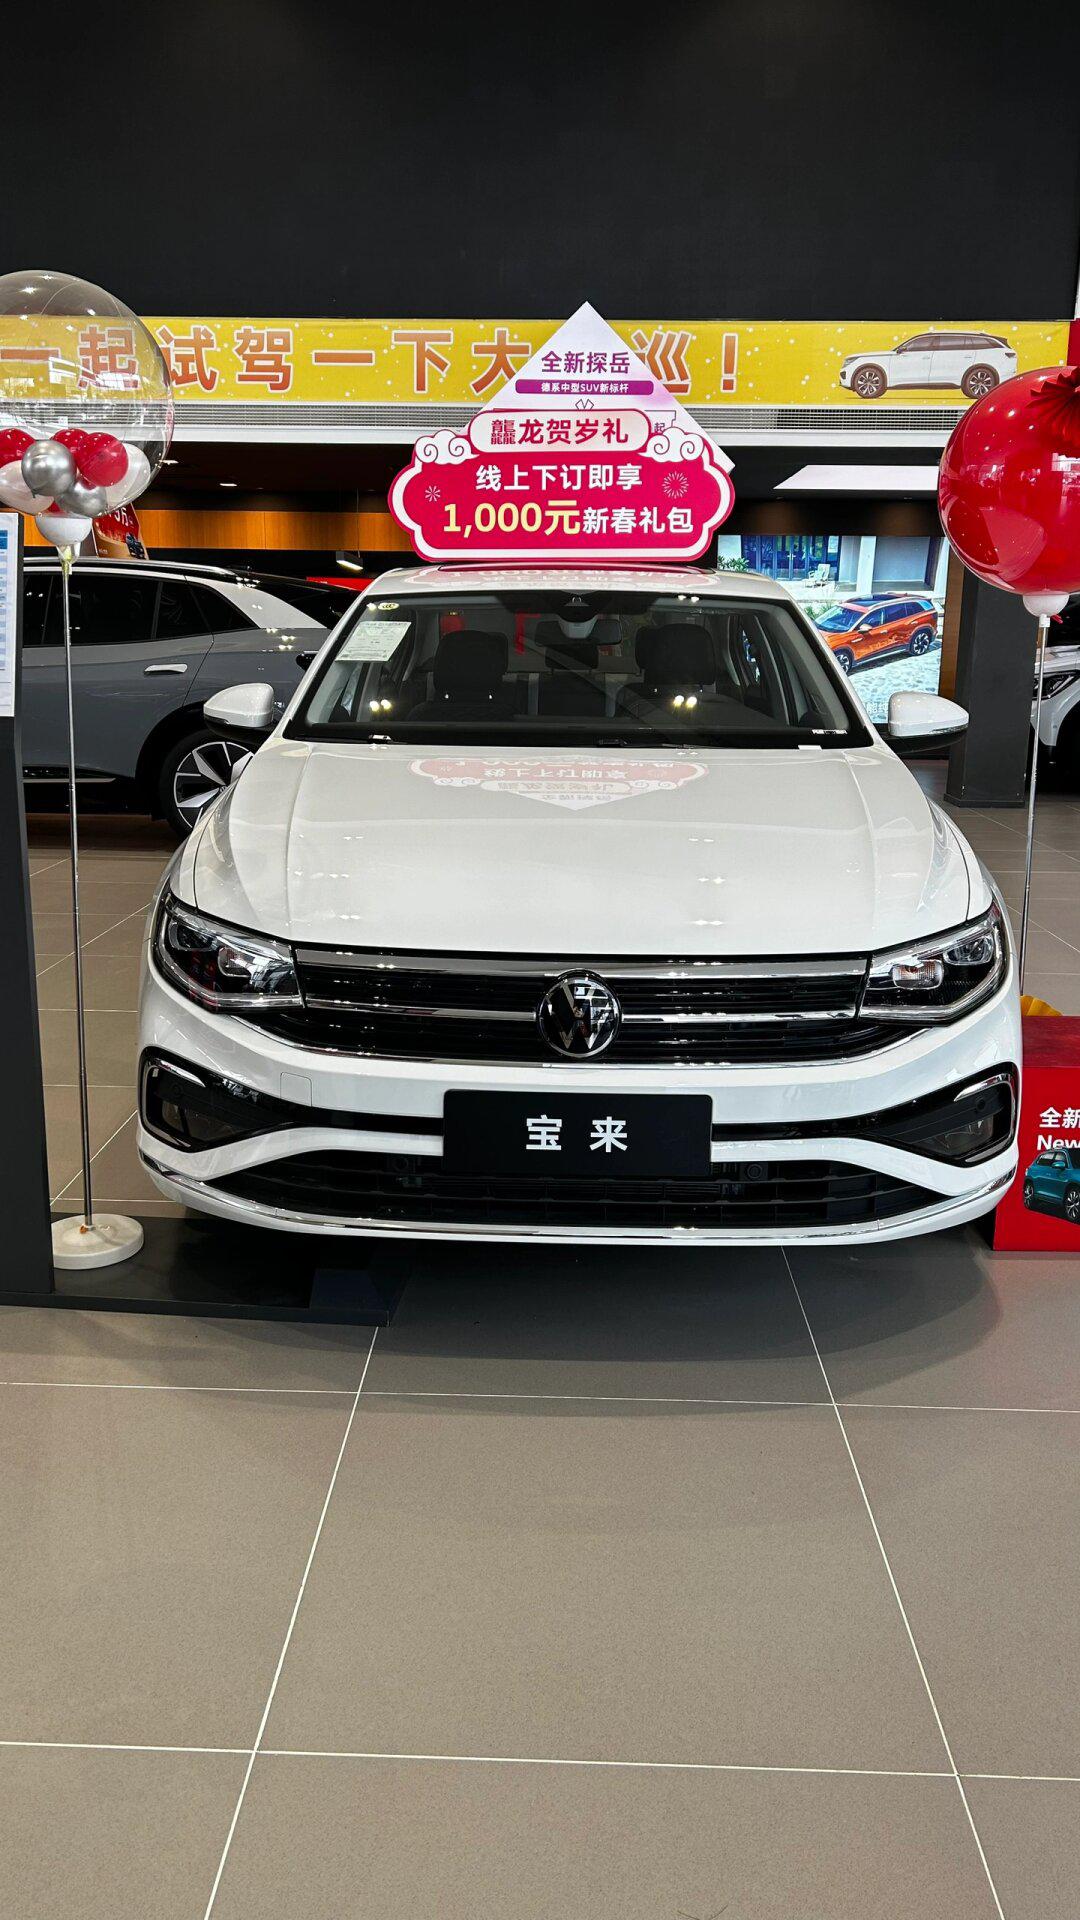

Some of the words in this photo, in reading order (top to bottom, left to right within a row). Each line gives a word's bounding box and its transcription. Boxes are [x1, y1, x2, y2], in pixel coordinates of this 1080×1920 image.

[540, 351, 631, 374] 全新探岳
[540, 381, 630, 394] 德系中型SUV新标杆
[475, 464, 643, 491] 线上下订即享
[443, 500, 694, 538] 1,000元新春礼包
[1039, 1106, 1080, 1129] 全新
